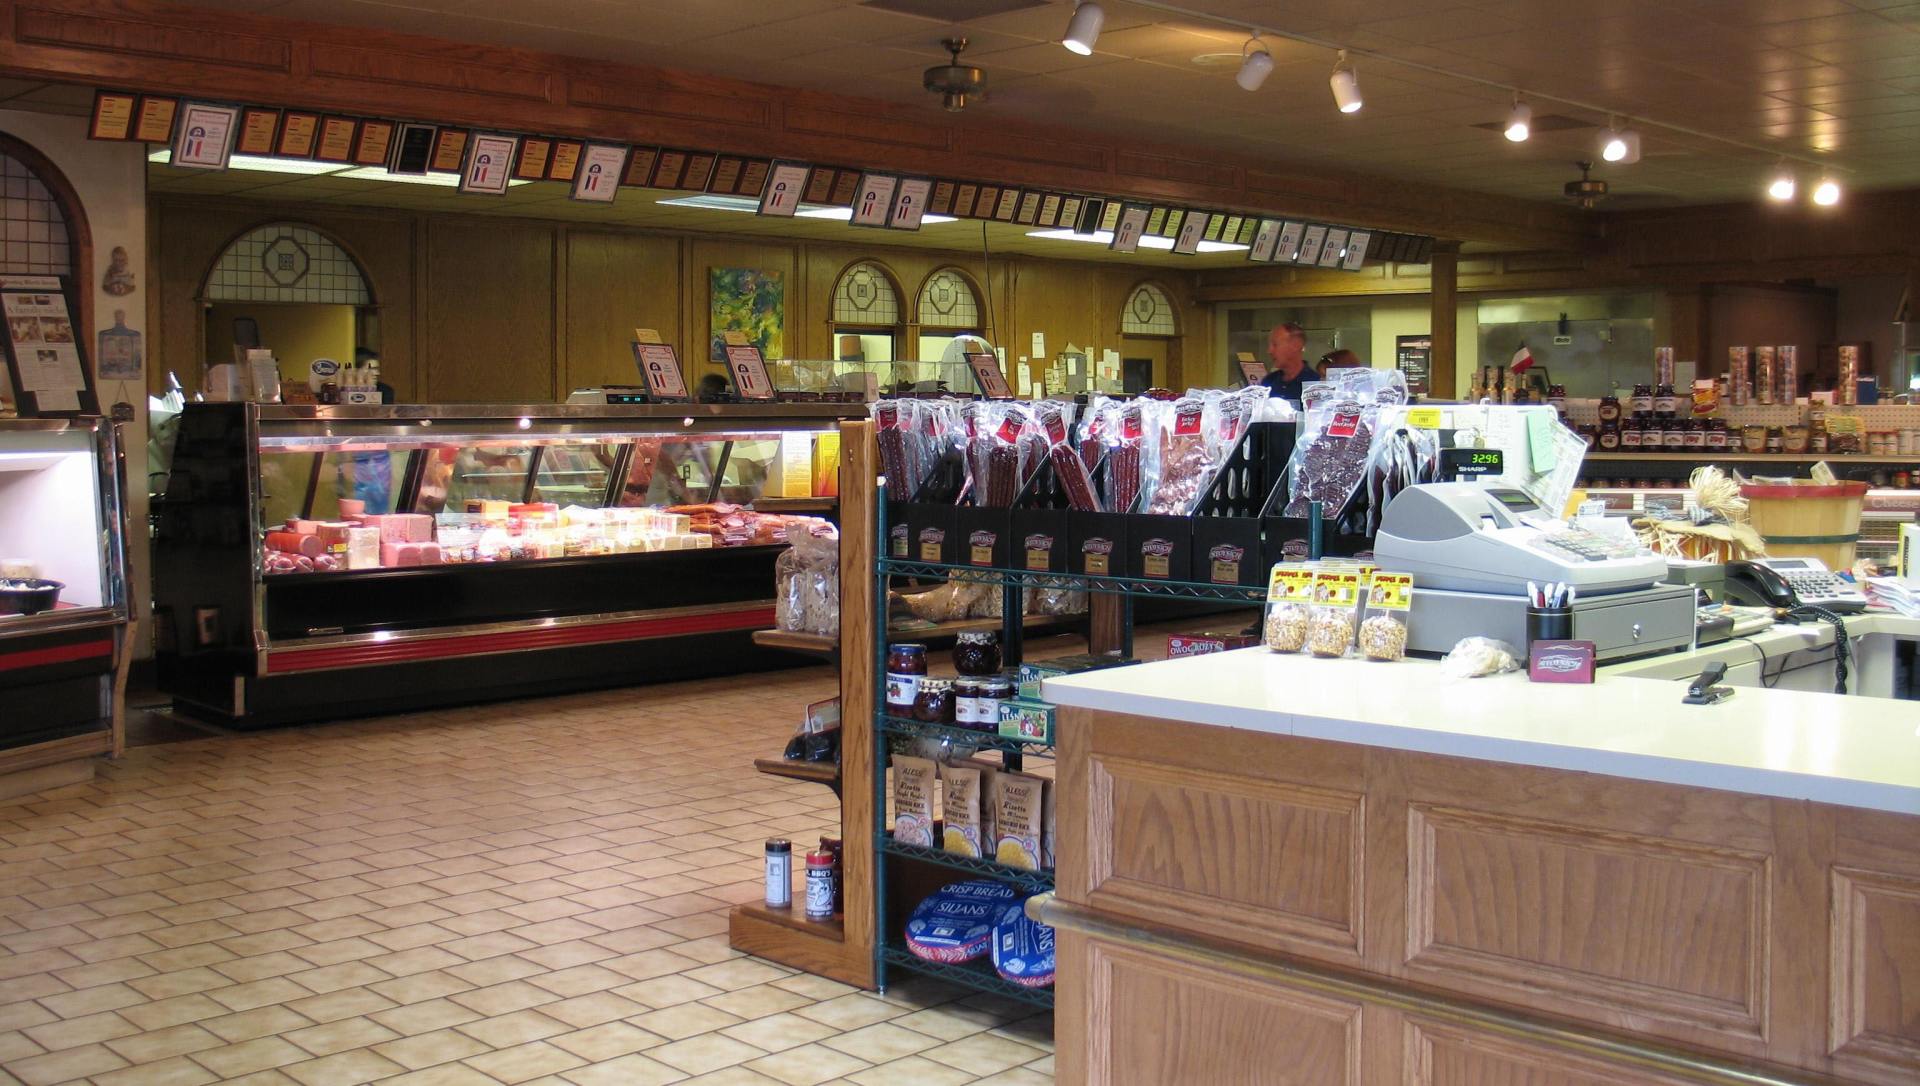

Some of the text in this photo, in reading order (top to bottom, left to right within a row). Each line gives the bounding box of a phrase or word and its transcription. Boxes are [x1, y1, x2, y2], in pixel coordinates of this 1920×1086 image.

[1472, 454, 1498, 464] 3296
[941, 884, 974, 893] CRISP
[973, 887, 1015, 898] BREAD
[937, 902, 987, 915] SILJANS
